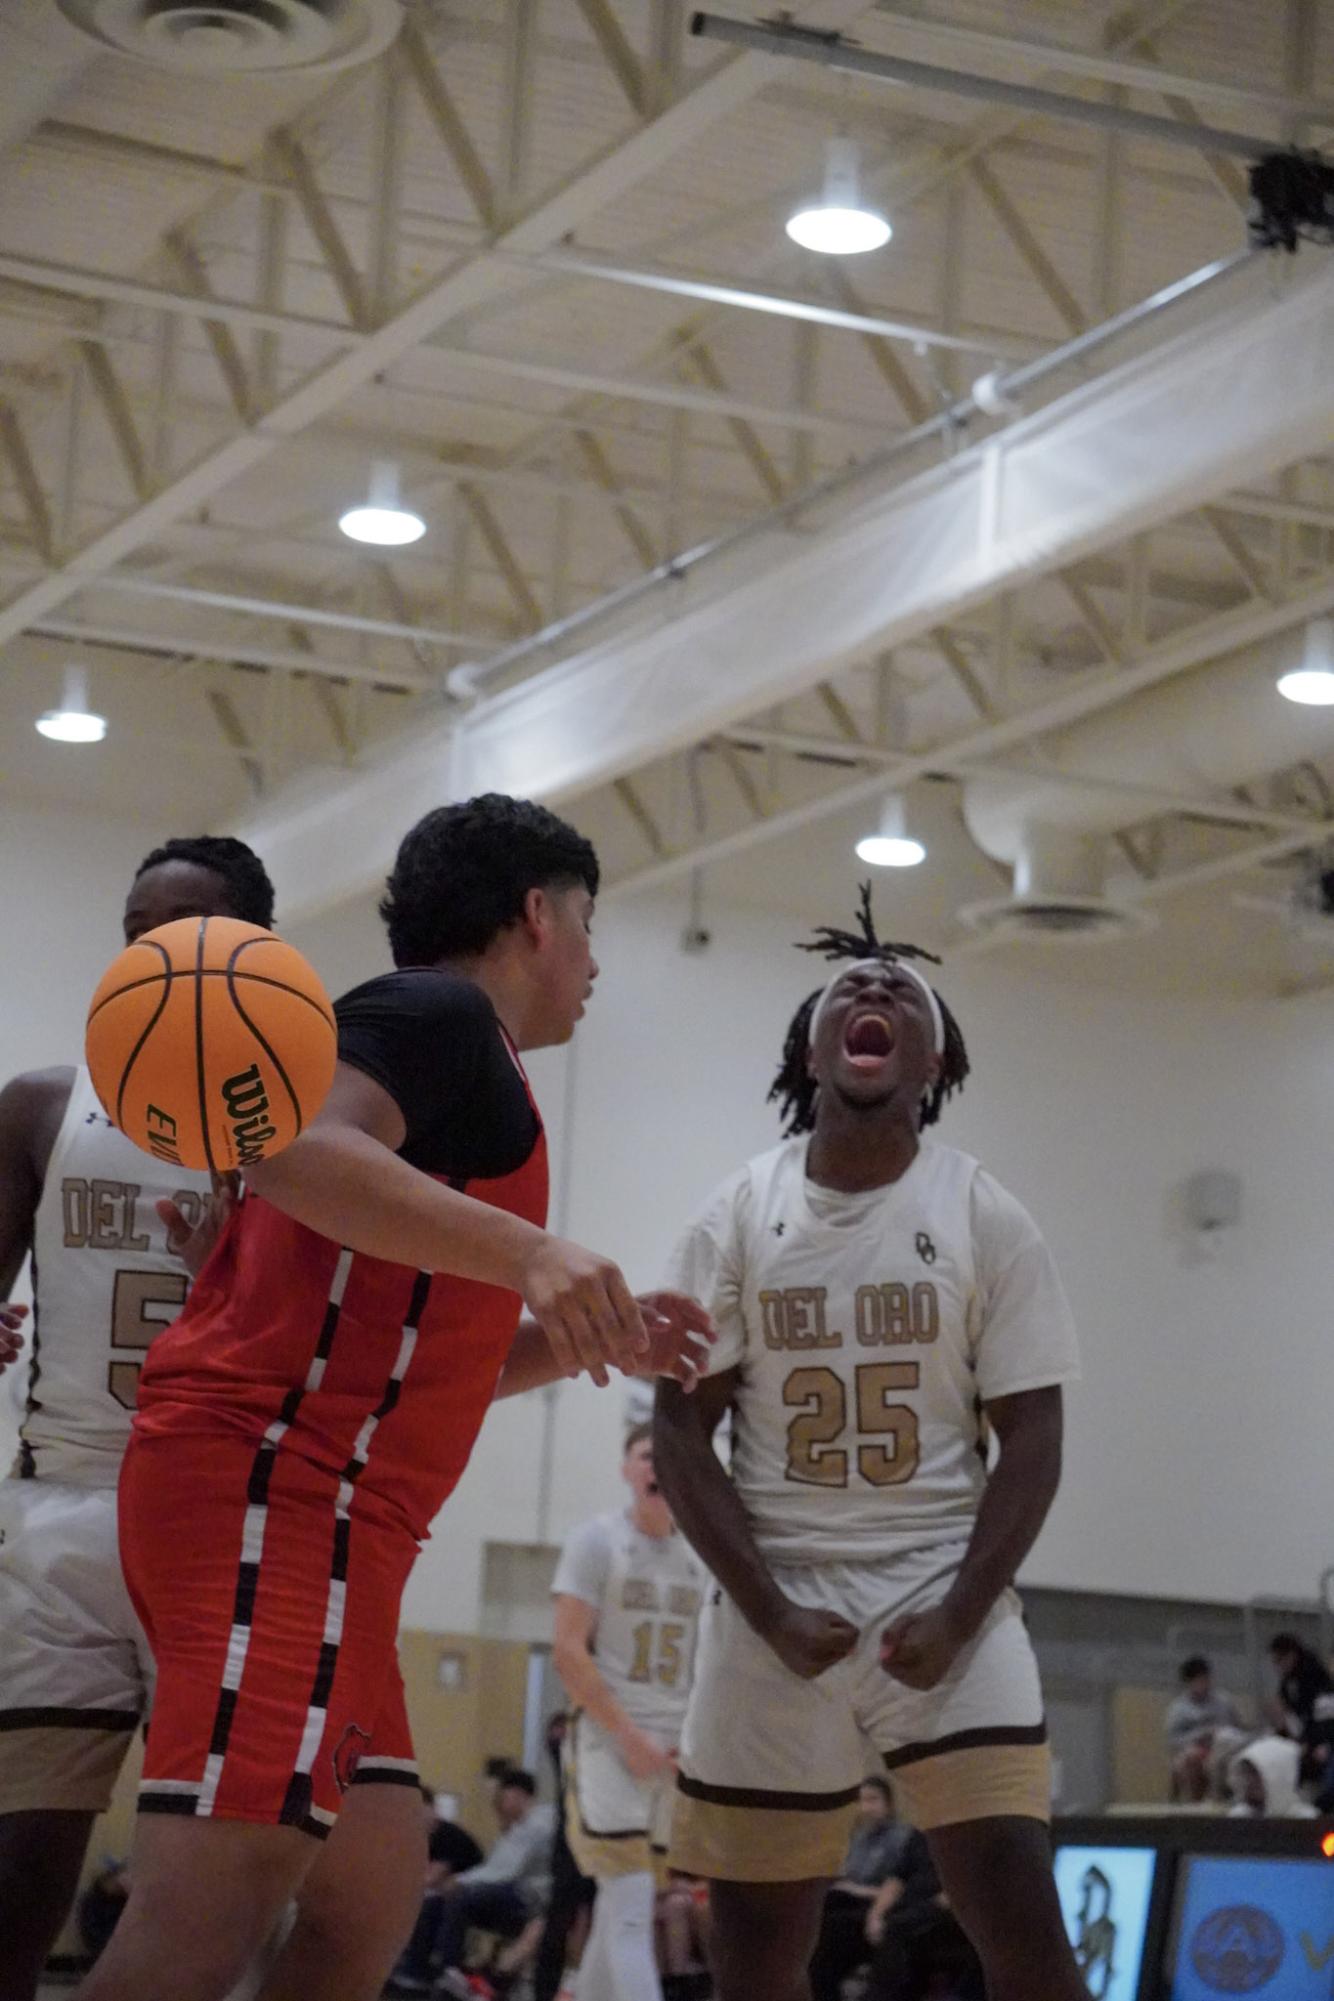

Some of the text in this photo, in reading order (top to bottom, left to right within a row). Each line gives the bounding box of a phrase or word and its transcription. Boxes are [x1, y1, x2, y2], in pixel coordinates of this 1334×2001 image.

[62, 1177, 151, 1251] DEL
[108, 1269, 190, 1411] 5
[758, 1281, 940, 1351] DEL ORO
[783, 1361, 920, 1488] 25
[627, 1621, 684, 1687] 15
